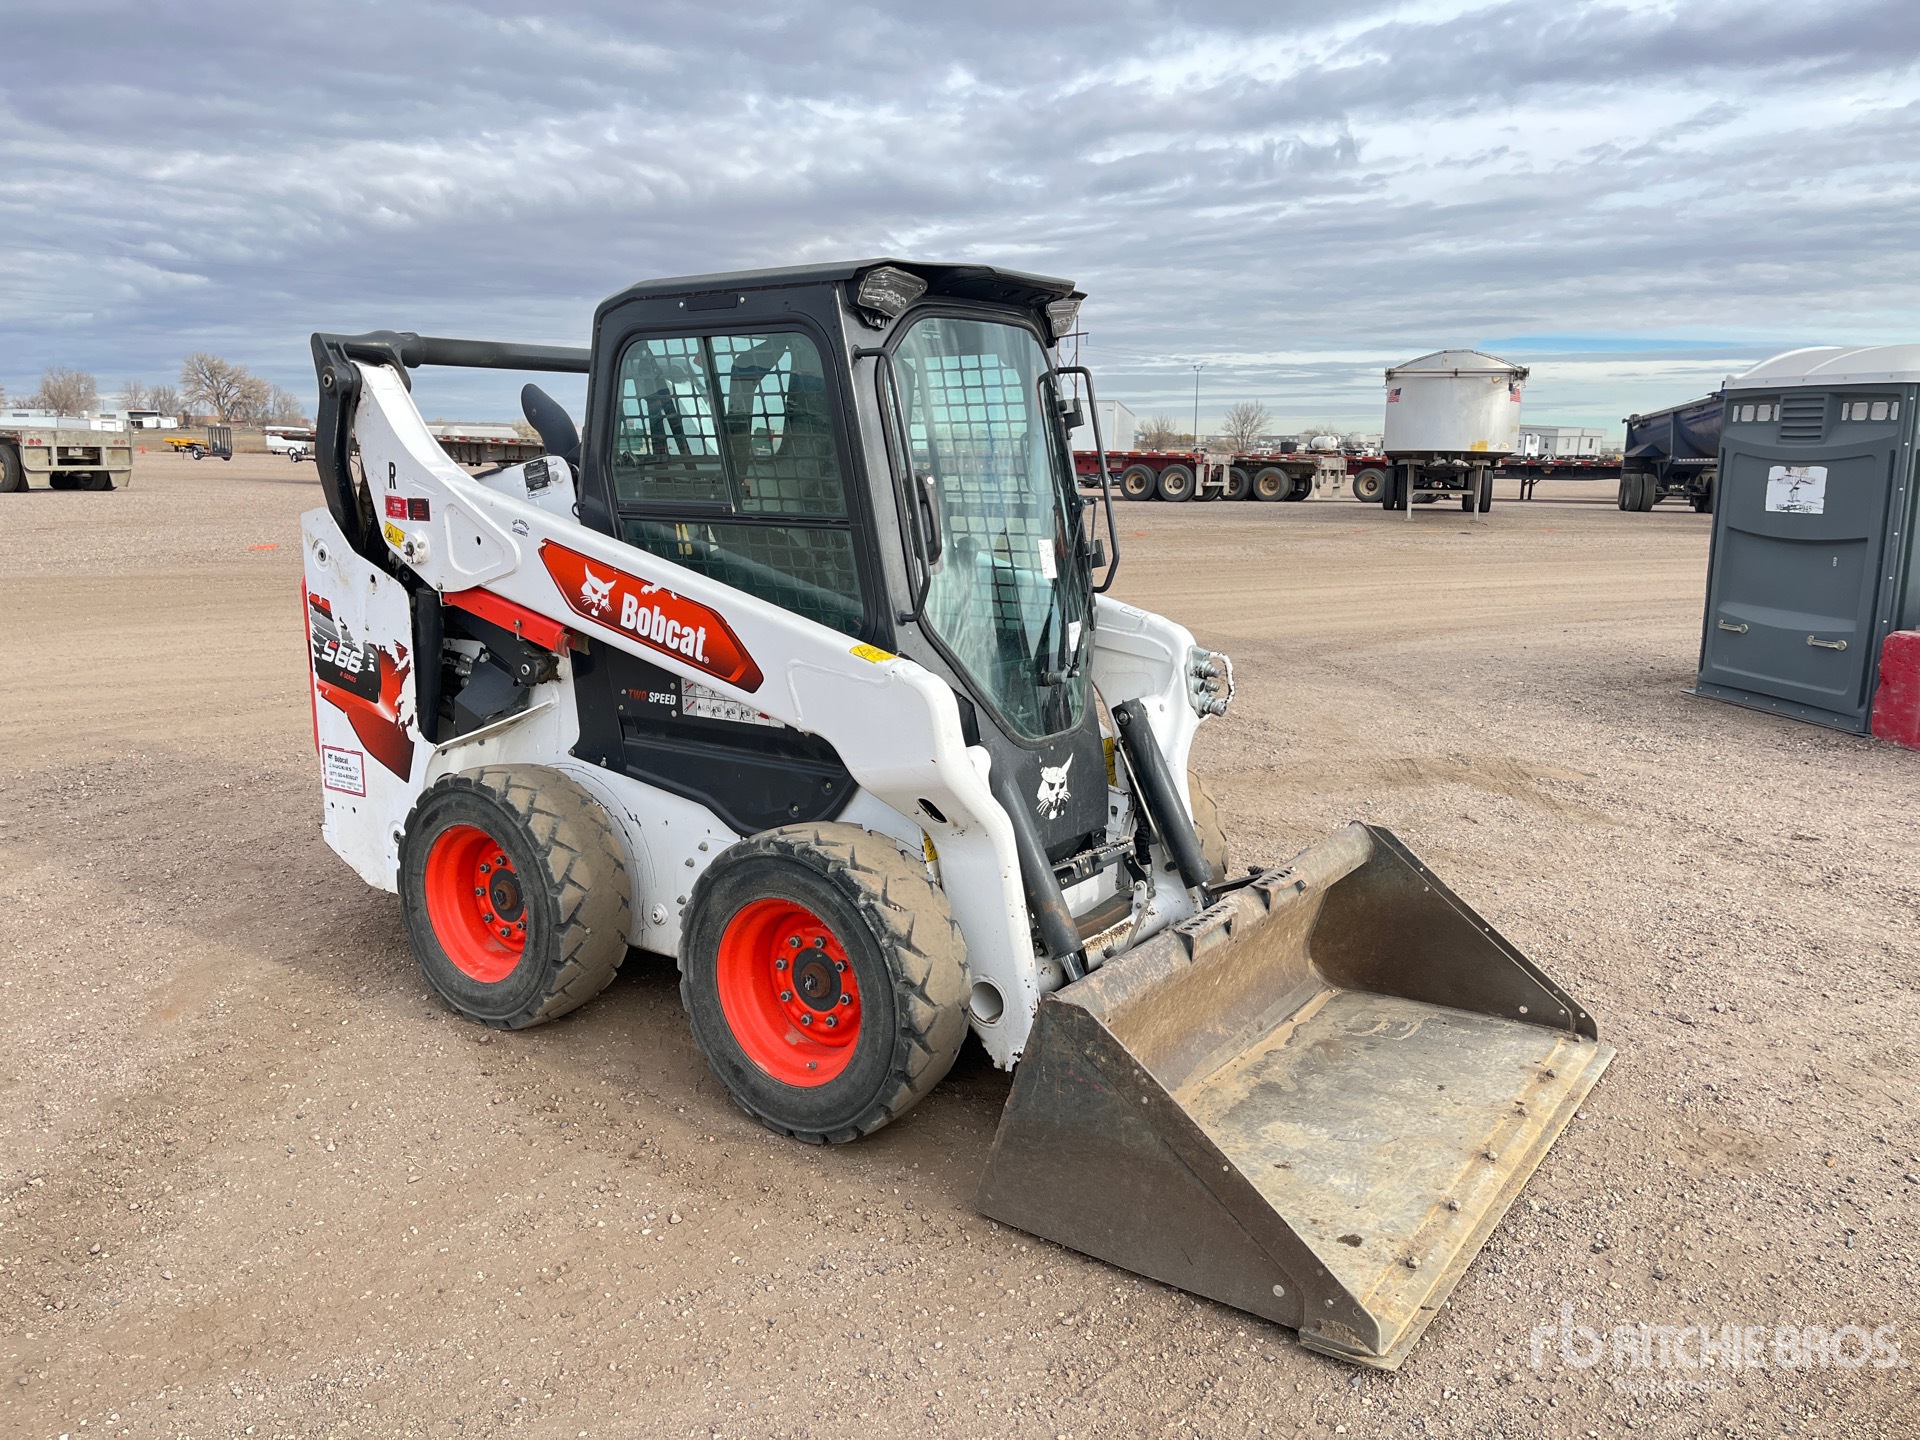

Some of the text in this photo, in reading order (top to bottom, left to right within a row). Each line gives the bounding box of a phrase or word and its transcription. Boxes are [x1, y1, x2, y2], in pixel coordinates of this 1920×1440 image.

[388, 461, 396, 490] R
[620, 592, 706, 662] Bobcat
[628, 689, 676, 705] TWO SPEED
